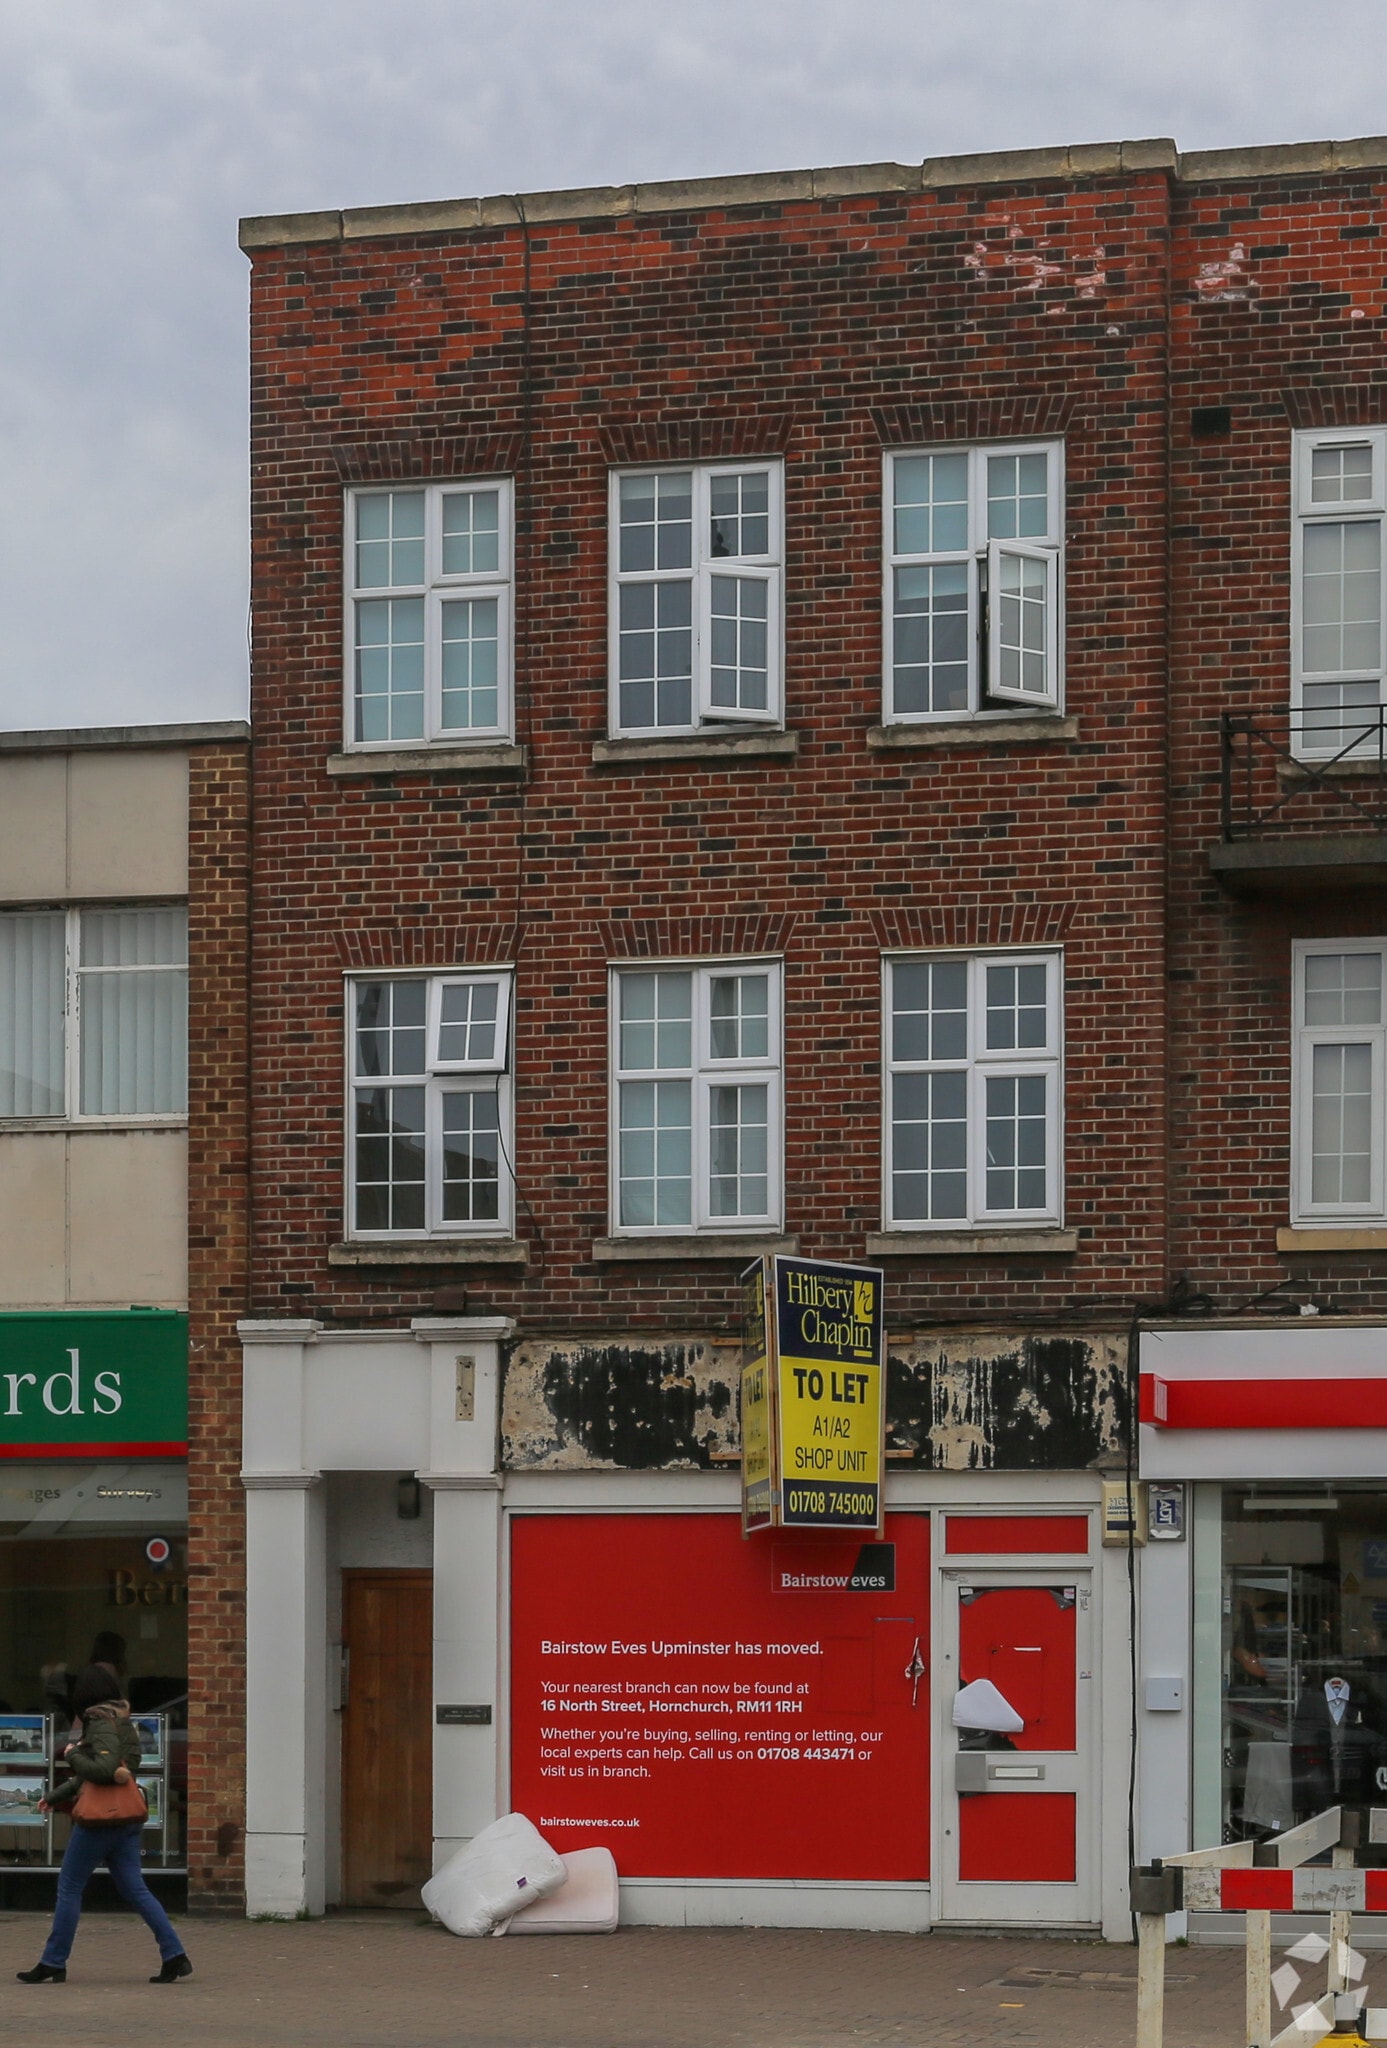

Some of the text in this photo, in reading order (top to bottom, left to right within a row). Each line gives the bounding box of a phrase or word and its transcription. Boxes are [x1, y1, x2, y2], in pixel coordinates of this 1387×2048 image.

[786, 1271, 853, 1318] Hilbery
[801, 1309, 872, 1355] Chaplin
[3, 1348, 122, 1415] rds
[793, 1368, 869, 1404] TO LET
[813, 1415, 851, 1439] A1/A2
[795, 1446, 868, 1472] SHOP UNIT
[96, 1485, 162, 1503] Surveys
[789, 1490, 825, 1514] 01708
[829, 1492, 874, 1515] 745000
[1159, 1500, 1174, 1525] ADT
[781, 1573, 886, 1588] Bairstow eves
[541, 1640, 824, 1658] Bairstow Eves Upminster has moved.
[541, 1680, 809, 1695] Your nearest branch can now be found at
[541, 1699, 803, 1715] 16 North Street, Hornchurch, RM11 1RH
[541, 1727, 884, 1745] Whether you're buying, selling, renting or letting, our
[540, 1745, 873, 1762] local experts can help. Call us on 01708 443471 or
[540, 1764, 652, 1778] visit us in branch.
[540, 1817, 641, 1829] bairstoweves.co.uk
